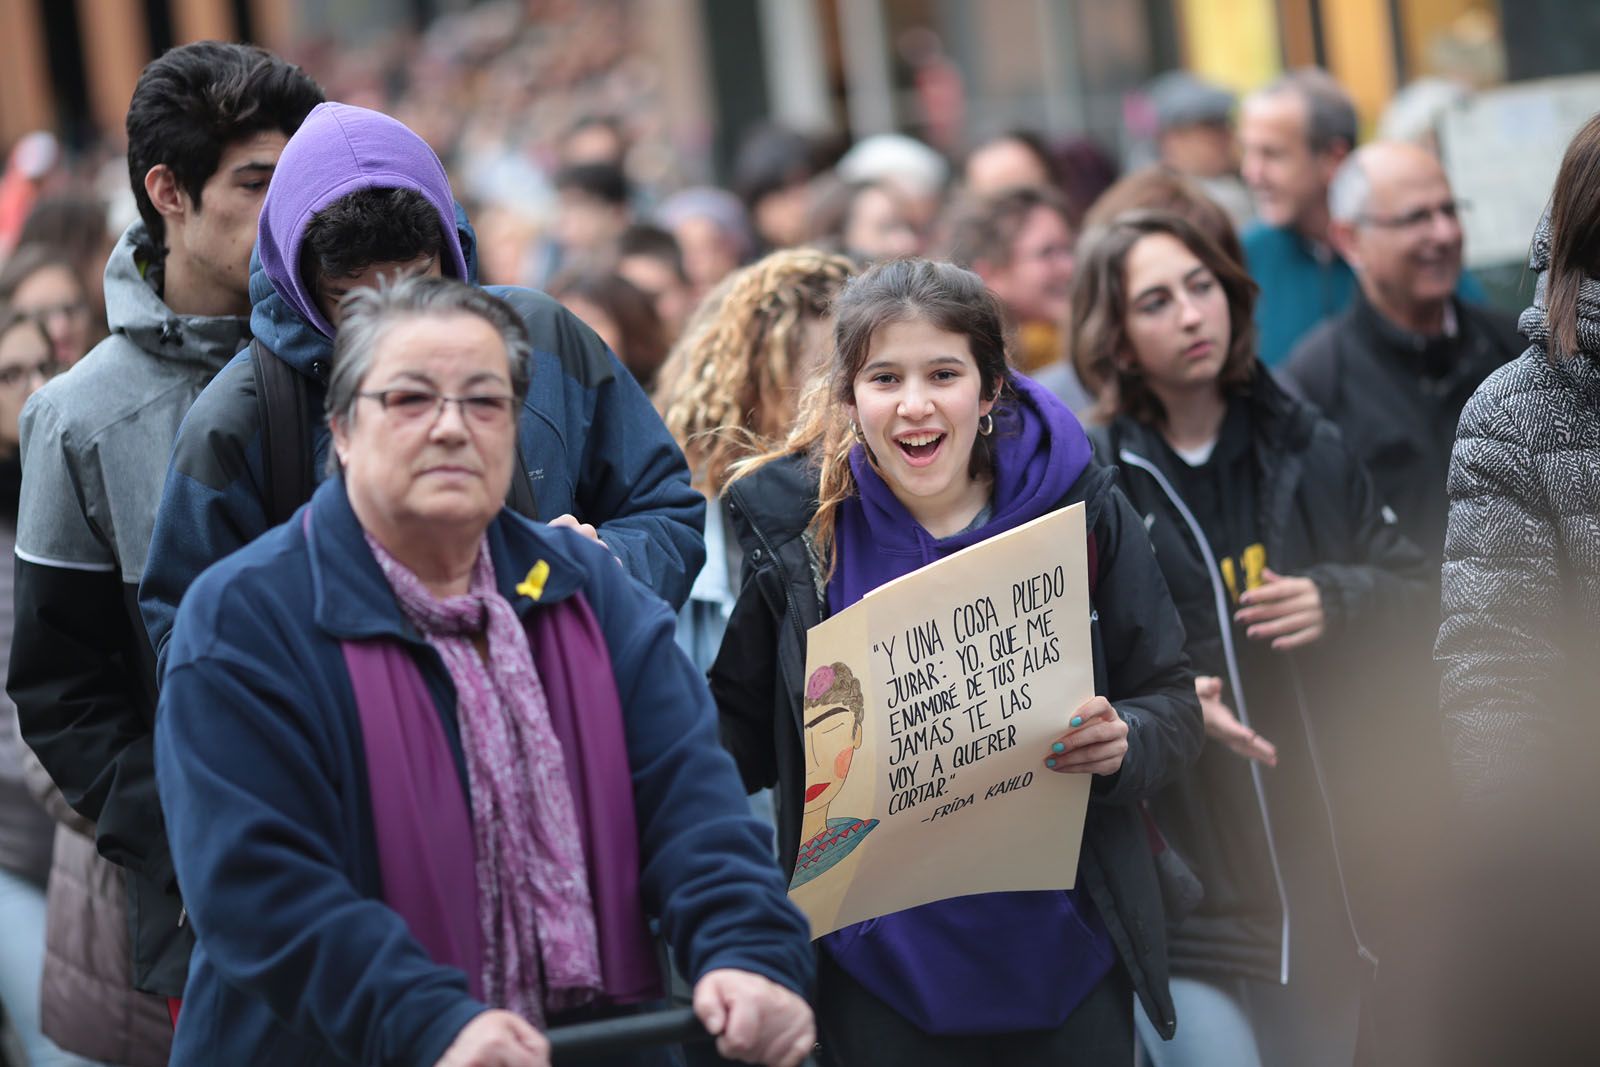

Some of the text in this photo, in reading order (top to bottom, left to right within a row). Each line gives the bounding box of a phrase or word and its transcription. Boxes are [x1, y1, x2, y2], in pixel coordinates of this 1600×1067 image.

[873, 565, 1064, 675] "Y UNA COSA PUEDO
[886, 609, 1055, 708] JURAR: YO, QUE ME
[889, 637, 1060, 736] ENAMORÉ DE TUS ALAS
[889, 683, 1032, 766] JAMÁS TE LAS
[888, 724, 1017, 792] VOY A QUERER
[984, 771, 1033, 800] KAHLO
